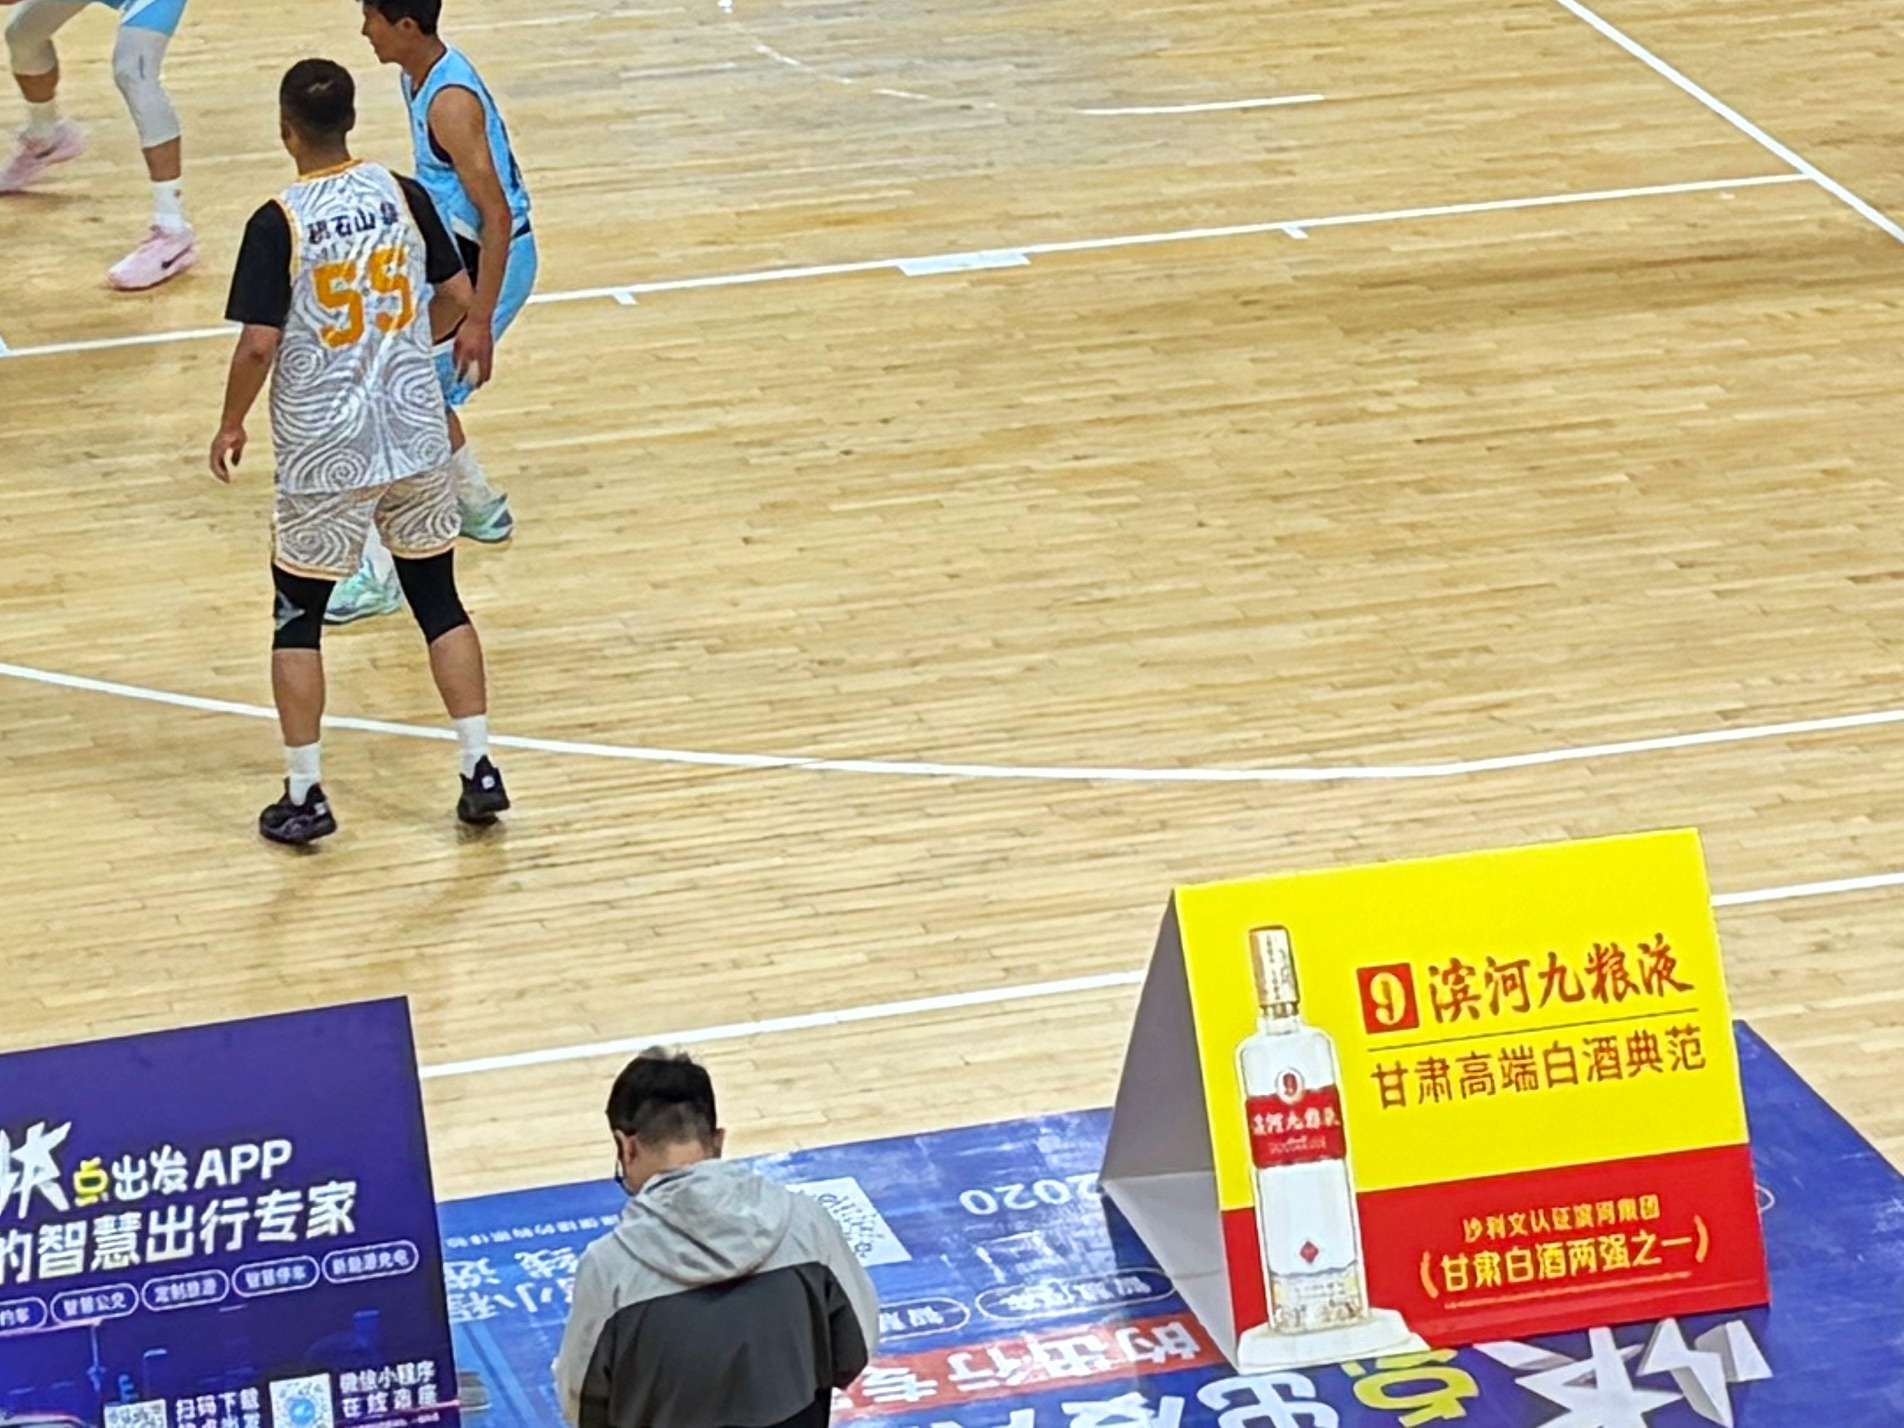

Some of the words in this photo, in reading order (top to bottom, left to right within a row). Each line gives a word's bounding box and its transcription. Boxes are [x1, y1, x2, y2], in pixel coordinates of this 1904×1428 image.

[311, 242, 418, 350] 55
[1367, 970, 1409, 1025] 9
[1427, 932, 1695, 1024] 滨河九粮液
[1370, 1023, 1707, 1110] 甘肃高端白酒典范
[831, 1323, 1201, 1406] 的出行专
